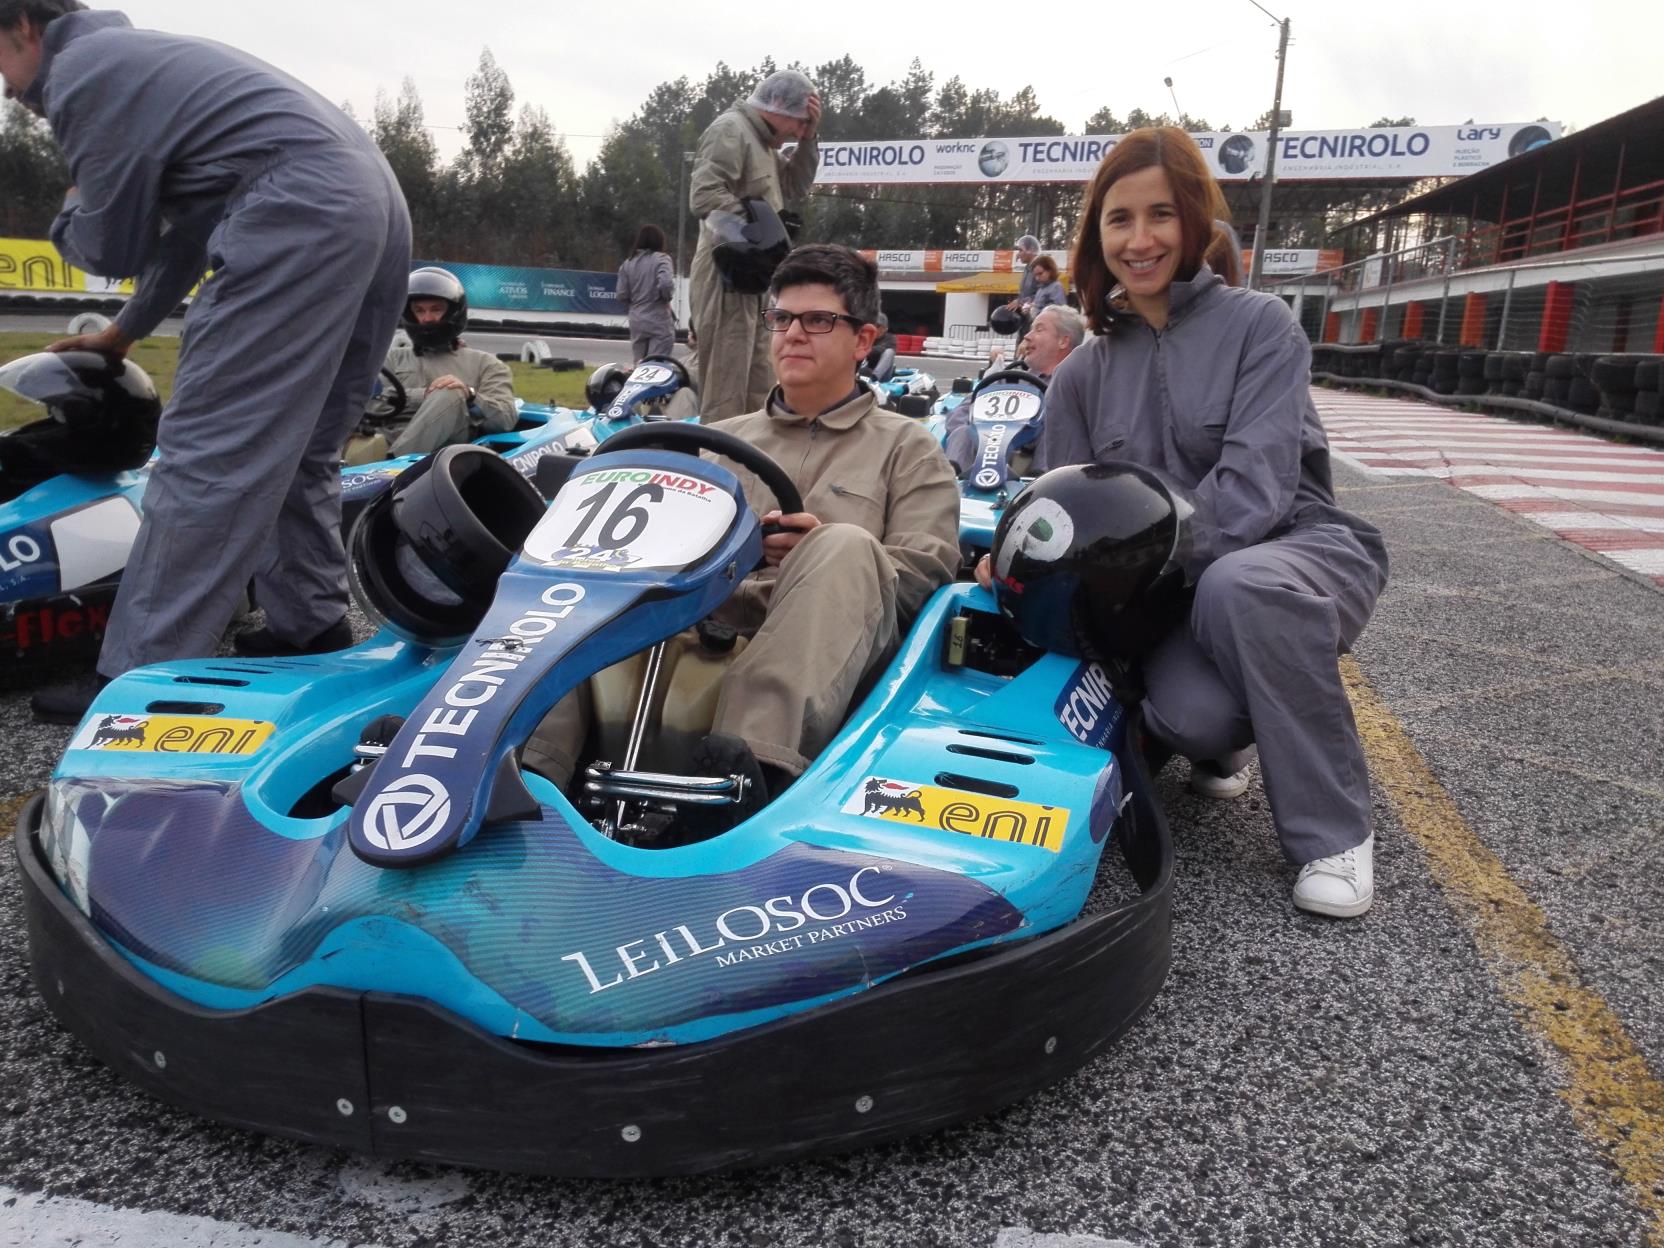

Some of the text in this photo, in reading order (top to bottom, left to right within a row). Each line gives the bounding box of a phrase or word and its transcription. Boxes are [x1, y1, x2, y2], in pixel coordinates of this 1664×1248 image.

[817, 145, 925, 166] ECNIROLO
[936, 141, 976, 153] worknc
[879, 253, 911, 262] HASCO
[945, 253, 980, 263] HASCO
[1264, 252, 1299, 263] ASCO
[543, 288, 575, 297] FINANCE
[634, 367, 660, 381] 24
[984, 395, 1021, 416] 30
[580, 470, 717, 495] EUROINDY
[562, 481, 664, 551] 16
[401, 582, 586, 768] TECNIROLO
[1060, 661, 1113, 742] ECNIR
[154, 720, 264, 754] eni
[938, 804, 1053, 847] eni
[714, 904, 907, 969] MARKET PARTNERS
